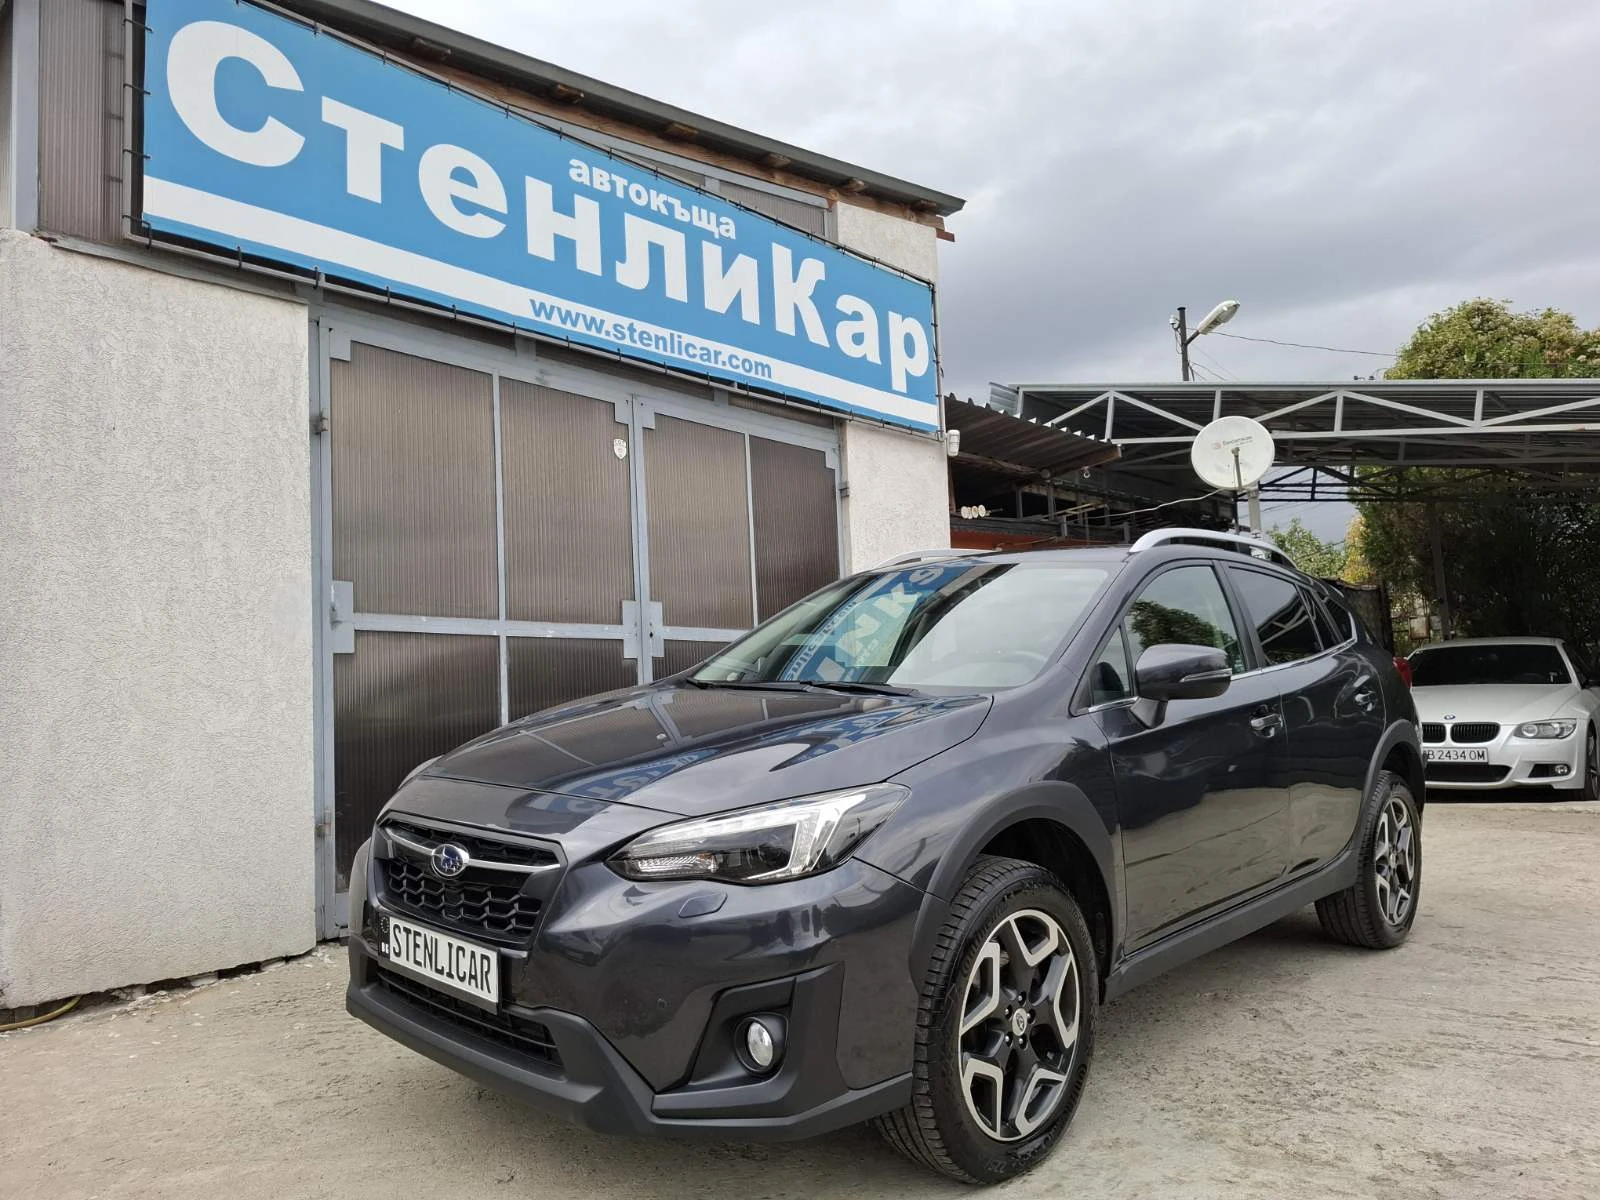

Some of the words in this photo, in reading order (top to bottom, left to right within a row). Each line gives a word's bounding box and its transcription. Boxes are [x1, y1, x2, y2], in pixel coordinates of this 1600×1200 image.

[167, 20, 929, 394] СтенлиКар
[568, 158, 737, 240] автокъща
[529, 298, 773, 378] www.stenlicar.com
[392, 923, 492, 994] STENLICAR
